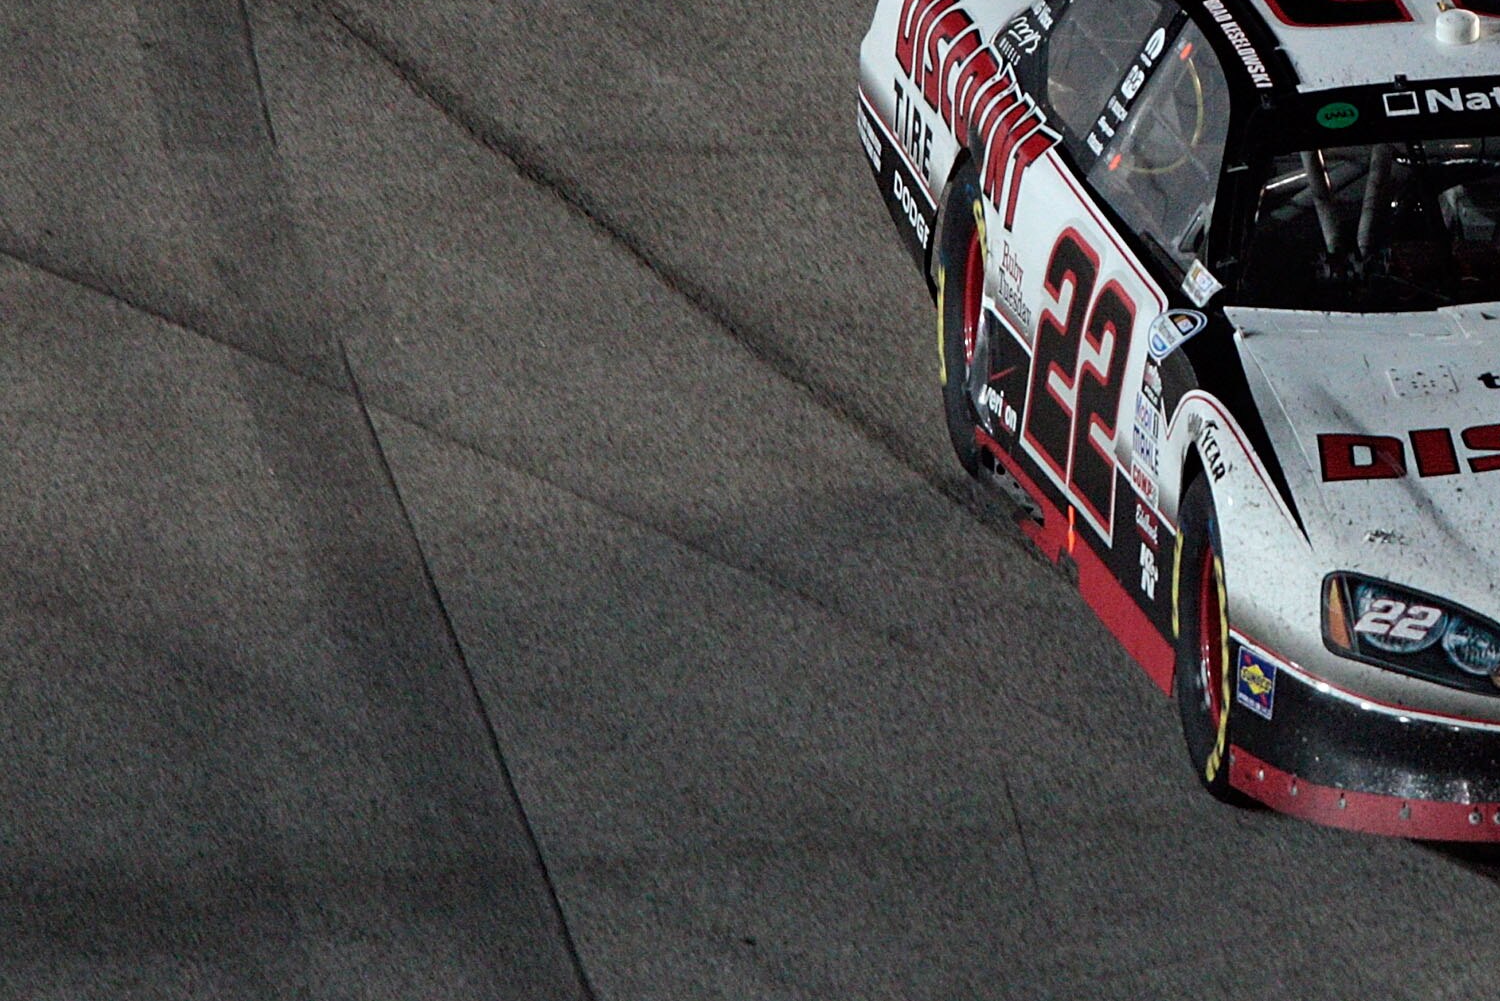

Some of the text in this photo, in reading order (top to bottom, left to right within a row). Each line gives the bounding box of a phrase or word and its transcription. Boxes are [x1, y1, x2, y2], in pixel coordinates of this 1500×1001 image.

[1220, 21, 1273, 88] KESELOWSKI
[894, 78, 933, 183] TIRE
[1002, 240, 1025, 289] Ruby
[1023, 226, 1137, 538] 22
[1201, 428, 1226, 483] YEAR
[1353, 598, 1445, 641] 22
